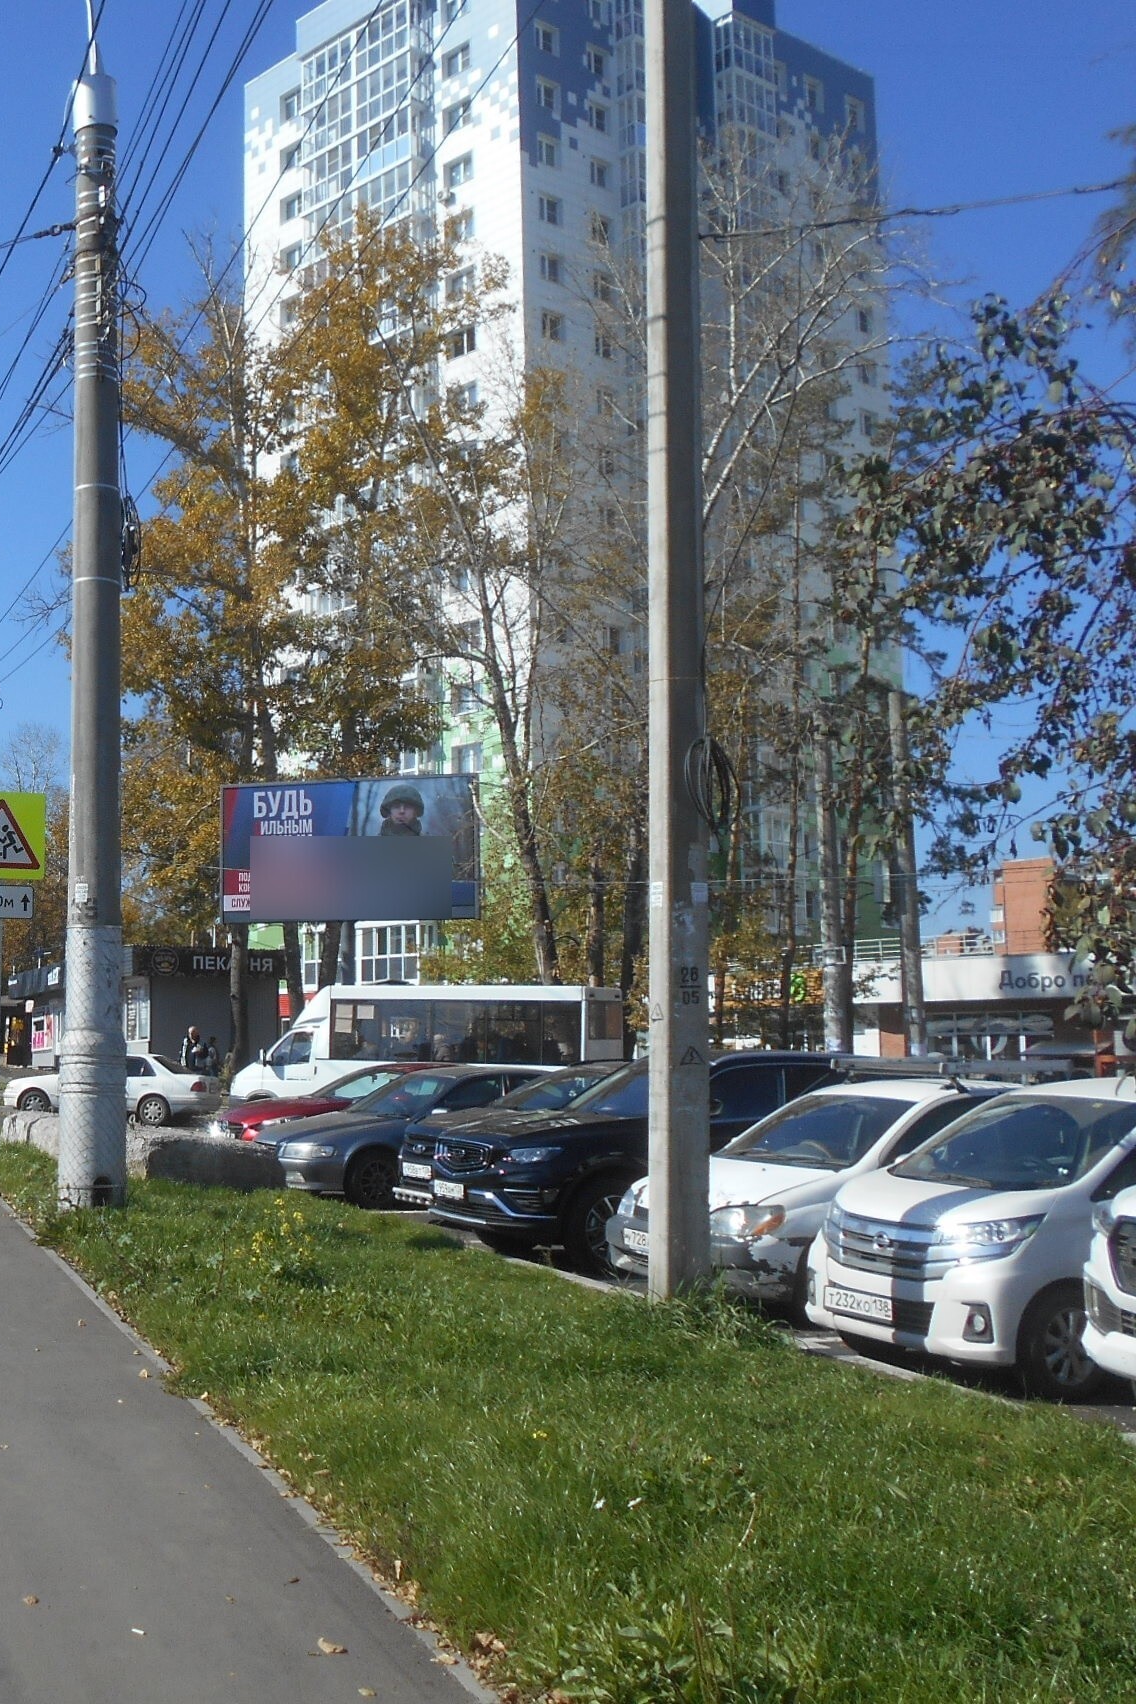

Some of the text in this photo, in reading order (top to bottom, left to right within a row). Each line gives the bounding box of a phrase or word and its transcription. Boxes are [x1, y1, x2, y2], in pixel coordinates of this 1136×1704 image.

[253, 789, 313, 820] БУДЬ
[998, 969, 1065, 992] Добро
[682, 990, 700, 1004] 05
